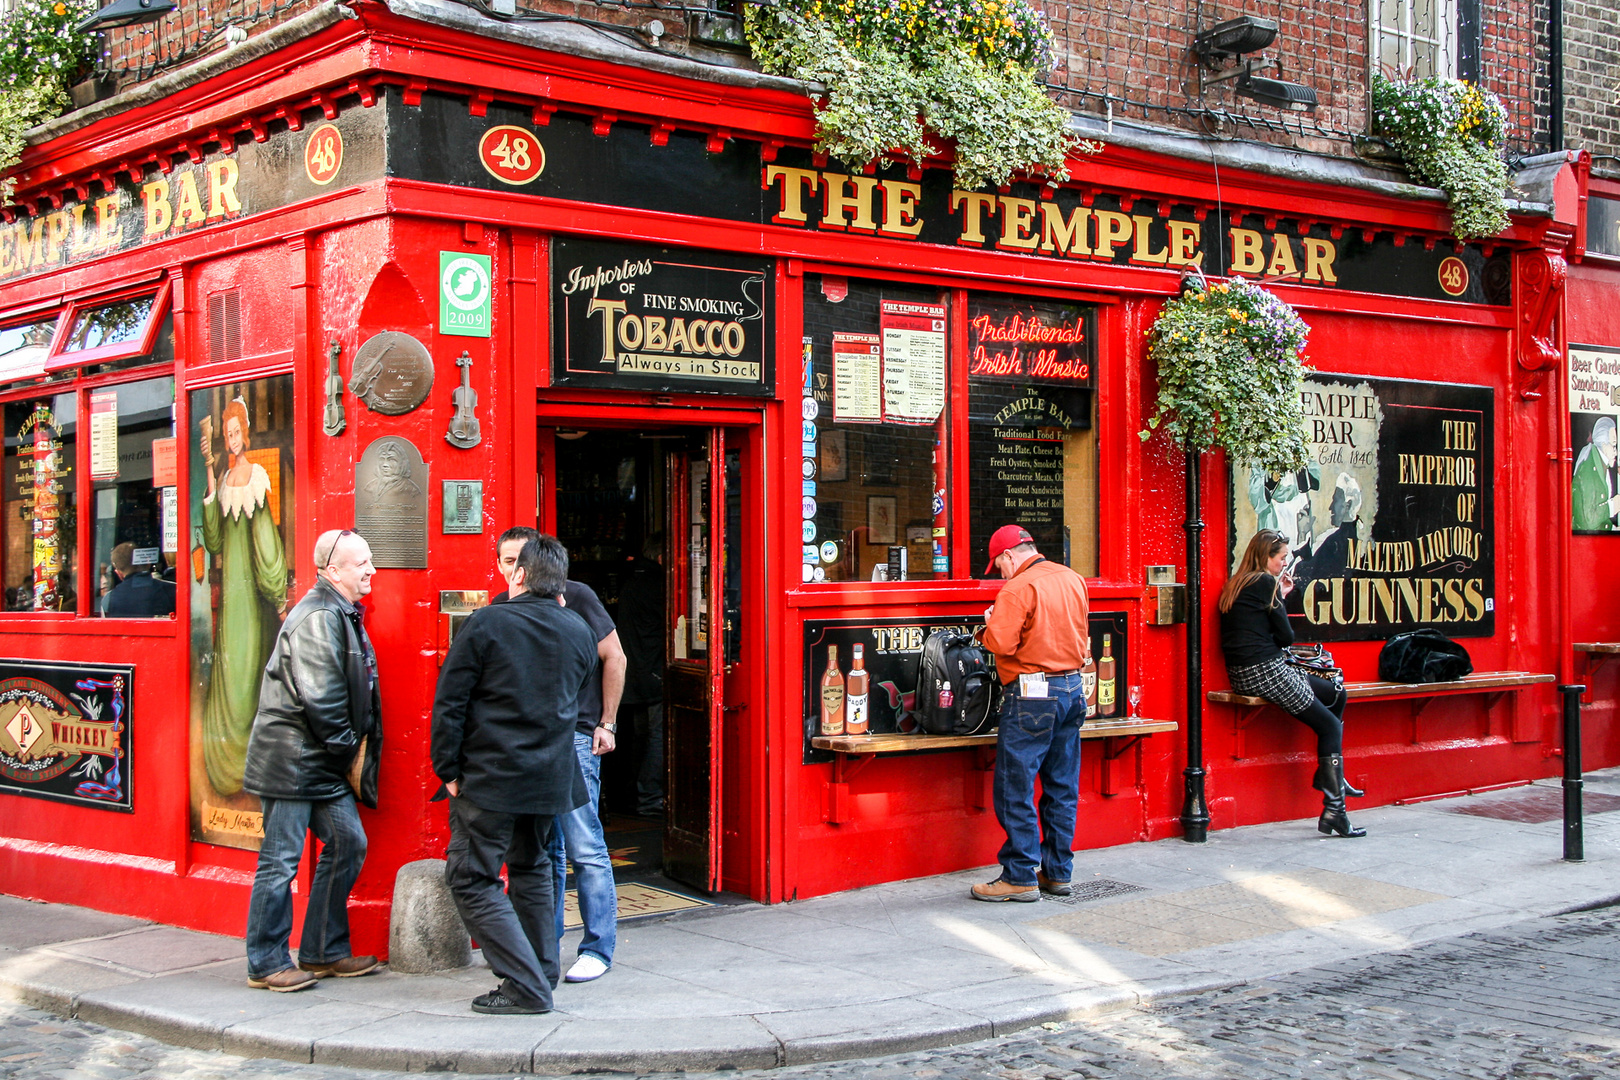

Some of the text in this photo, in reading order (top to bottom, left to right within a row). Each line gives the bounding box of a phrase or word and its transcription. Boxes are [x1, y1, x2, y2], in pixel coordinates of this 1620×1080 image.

[311, 136, 336, 175] 48
[490, 134, 531, 171] 48
[141, 158, 242, 242] BAR
[762, 164, 1338, 286] THE TEMPLE BAR
[561, 258, 653, 298] Importers
[619, 282, 636, 294] OF
[1443, 263, 1462, 287] 48
[449, 311, 483, 325] 2009
[643, 293, 745, 316] FINE SMOKING
[883, 303, 945, 316] THE TEMPLE BAR
[587, 298, 746, 363] TOBACCO
[972, 314, 1085, 343] Traditional
[621, 354, 757, 377] Always in Stock
[970, 345, 1090, 379] Irish Music
[1571, 354, 1593, 374] Beer
[1027, 388, 1039, 396] The
[1571, 373, 1610, 397] Smoking
[993, 397, 1073, 430] TEMPLE BAR
[1300, 391, 1377, 420] EMPLE
[1578, 393, 1602, 411] Area
[993, 428, 1073, 441] Traditional Food Fare
[1311, 419, 1357, 448] BAR
[1442, 419, 1476, 451] THE
[990, 457, 1007, 467] Fresh
[1008, 458, 1032, 470] Oysters,
[1033, 459, 1057, 469] Smoked
[998, 444, 1013, 454] Meat
[1015, 444, 1032, 455] Plate,
[1033, 445, 1054, 456] Cheese
[1349, 450, 1374, 466] 1840
[998, 471, 1033, 481] Charcuterie
[1034, 472, 1054, 482] Meats,
[1398, 453, 1476, 488] EMPEROR
[1004, 498, 1017, 507] Hot
[1018, 498, 1035, 508] Roast
[1036, 499, 1050, 508] Beef
[1006, 485, 1065, 495] Toasted Sandwiches
[1456, 492, 1476, 523] OF
[1345, 525, 1483, 574] MALTED LIQUORS
[1303, 577, 1486, 626] GUINNESS
[871, 626, 924, 654] THE
[8, 680, 28, 688] LANE
[30, 680, 69, 707] DISTILLERY
[20, 713, 33, 748] P
[51, 721, 107, 748] WHISKEY
[13, 769, 34, 780] POT
[39, 764, 67, 779] STILL
[209, 809, 228, 829] Lady
